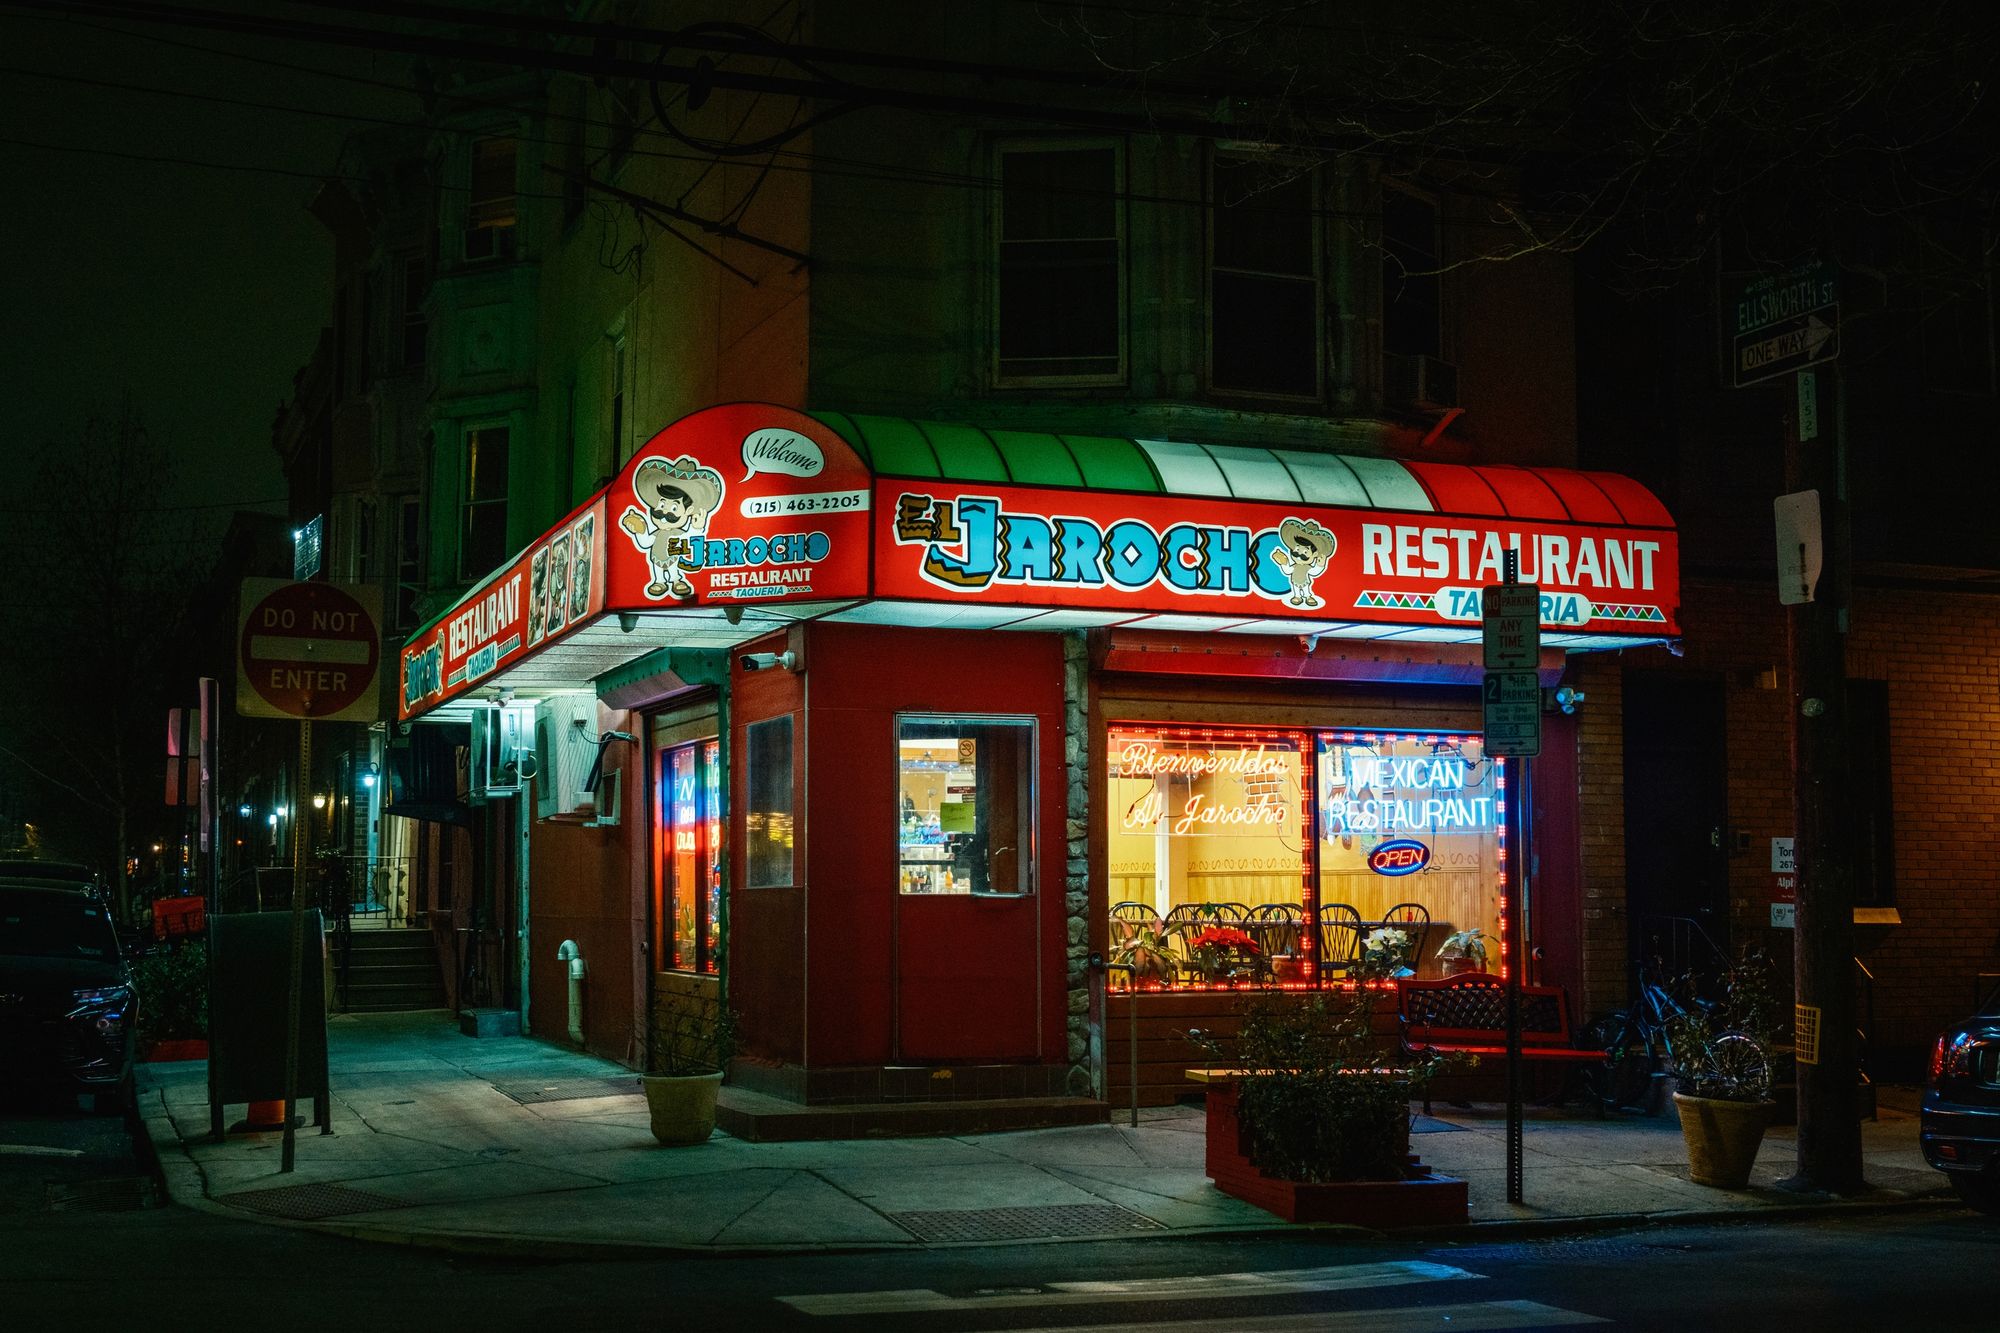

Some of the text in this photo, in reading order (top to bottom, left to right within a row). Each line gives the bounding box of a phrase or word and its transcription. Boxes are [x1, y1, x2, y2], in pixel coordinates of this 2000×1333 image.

[1738, 281, 1817, 330] ELLSWORTH
[1746, 329, 1808, 367] ONE WAY
[752, 436, 818, 470] Welcome
[749, 495, 860, 514] (215) 463-2205
[898, 494, 961, 542] EL
[678, 531, 830, 572] JAROCHO
[1361, 523, 1660, 590] RESTAURANT
[710, 568, 813, 587] RESTAURANT
[735, 586, 784, 598] TAQUERIA
[1448, 590, 1579, 623] TARIA
[1486, 594, 1535, 607] NO PARKING
[263, 608, 360, 632] DO NOT
[449, 573, 522, 662] RESTAURANT
[1500, 620, 1523, 632] ANY
[1500, 636, 1524, 648] TIME
[270, 668, 347, 692] ENTER
[1487, 676, 1528, 700] 2 HR
[1502, 689, 1536, 701] PARKING
[1120, 743, 1290, 775] Bienvenidos
[1351, 758, 1463, 789] MEXICAN
[1175, 794, 1287, 835] Jarocho
[1328, 797, 1491, 829] RESTAURANT
[1374, 848, 1424, 868] OPEN
